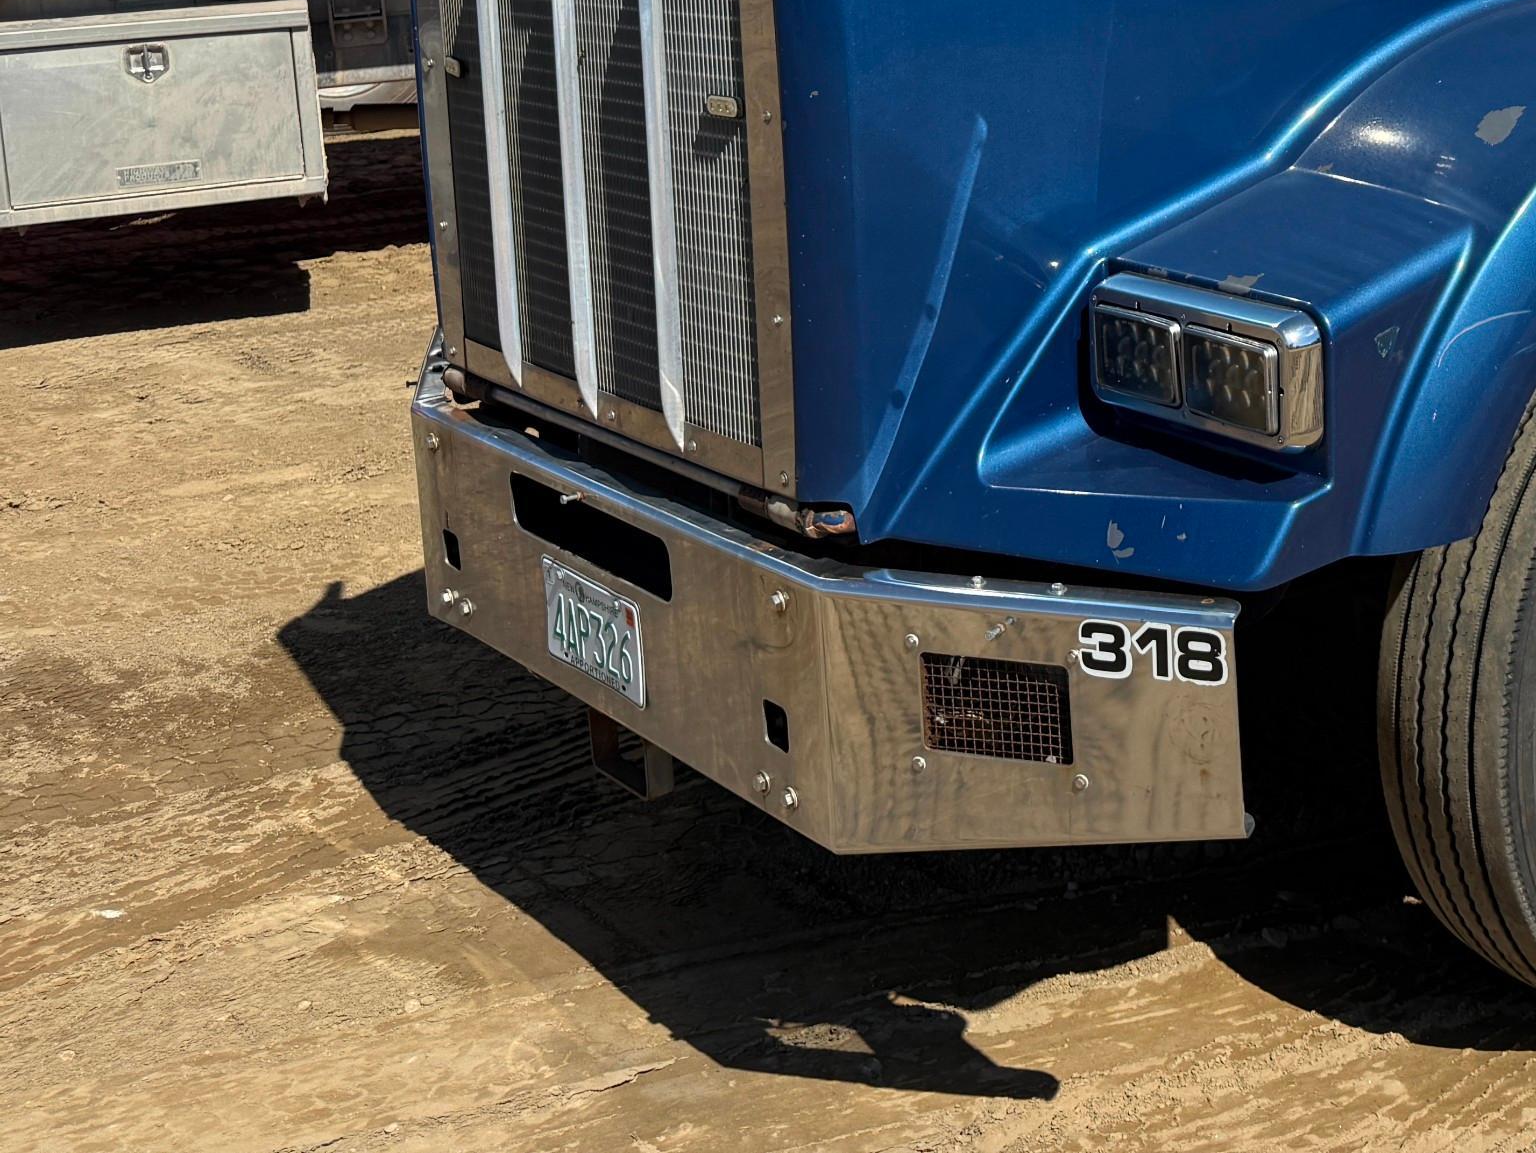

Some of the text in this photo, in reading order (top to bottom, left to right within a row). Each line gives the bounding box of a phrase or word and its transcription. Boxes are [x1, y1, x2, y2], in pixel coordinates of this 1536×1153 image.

[554, 593, 632, 684] 4AP326
[1079, 619, 1229, 686] 318
[570, 655, 621, 692] APPORTIONED
